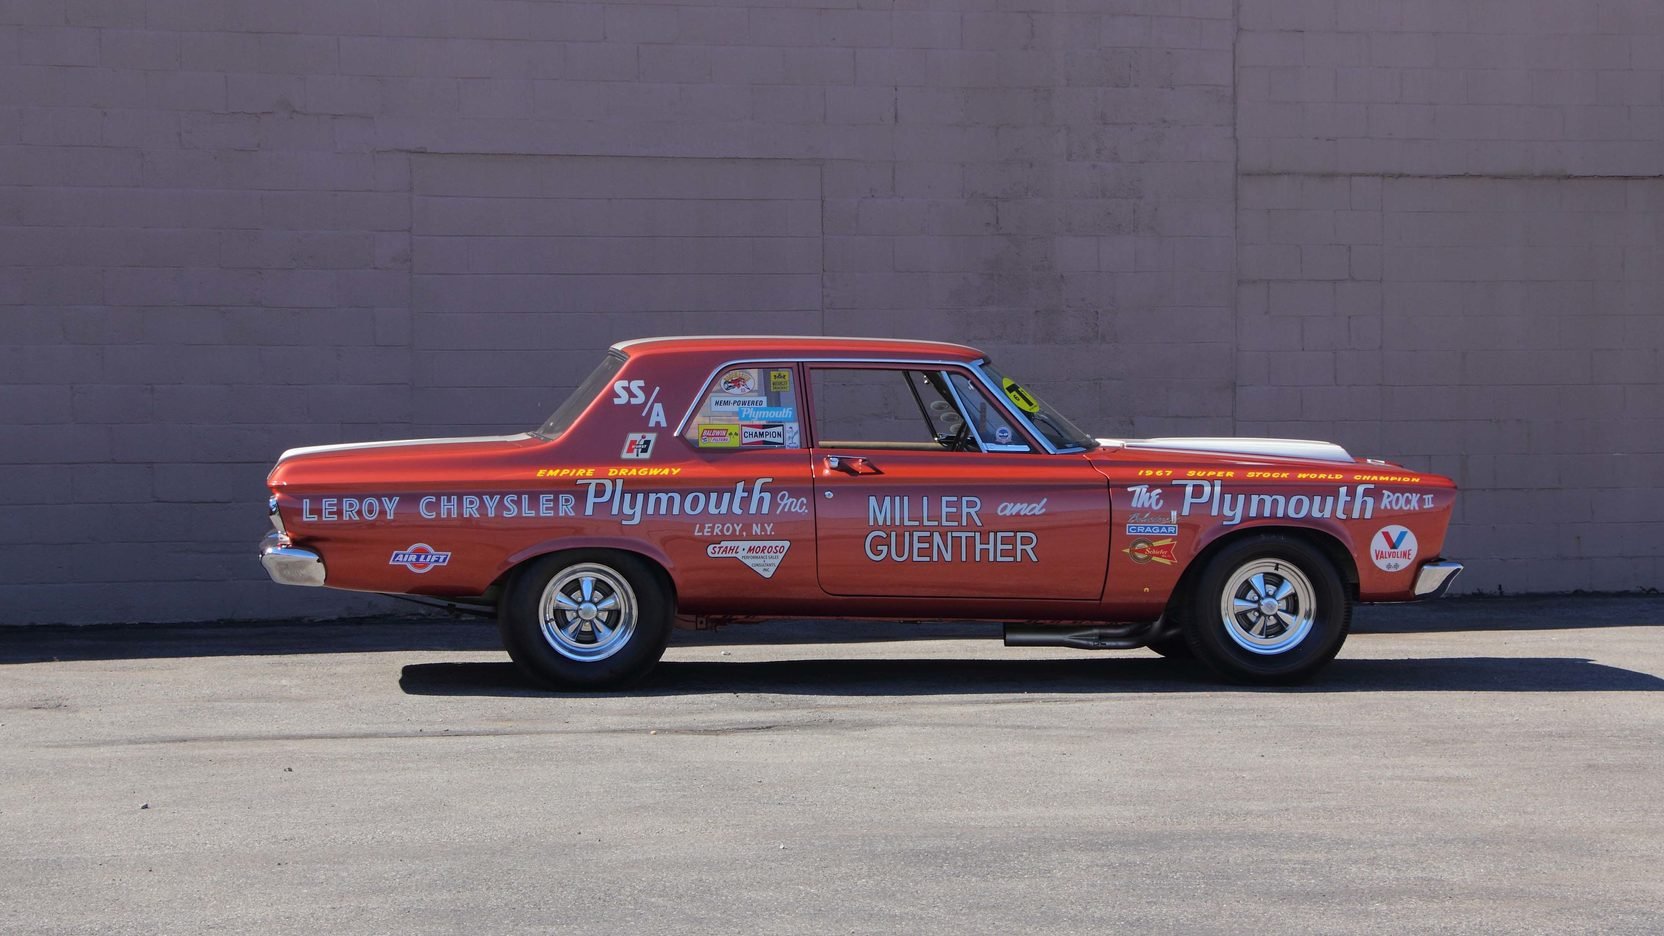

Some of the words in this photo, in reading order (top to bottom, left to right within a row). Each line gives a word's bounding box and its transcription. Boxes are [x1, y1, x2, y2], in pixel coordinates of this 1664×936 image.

[741, 407, 793, 418] Plymouth
[743, 430, 782, 439] CHAMPION
[536, 468, 595, 477] EMPIRE
[608, 468, 681, 477] DRAGWAY
[1246, 471, 1289, 479] STOCK
[1297, 472, 1344, 480] WORLD
[1353, 474, 1421, 483] CHAMPION
[302, 496, 399, 522] LEROY
[419, 494, 575, 519] CHRYSLER
[575, 477, 774, 525] Plymouth
[776, 491, 809, 514] Inc.
[1171, 479, 1375, 525] Plymouth
[1380, 490, 1421, 511] ROCK
[1423, 494, 1435, 509] II
[868, 495, 983, 527] MILLER
[997, 498, 1047, 516] and
[694, 523, 747, 537] LEROY,
[752, 523, 775, 535] N.Y.
[1129, 526, 1175, 534] CRAGAR
[711, 545, 740, 554] STAHL
[747, 545, 785, 554] MOROSO
[864, 530, 1039, 562] GUENTHER
[394, 554, 417, 562] AIR
[419, 554, 447, 562] LIFT
[1375, 549, 1412, 560] VALVOLINE
